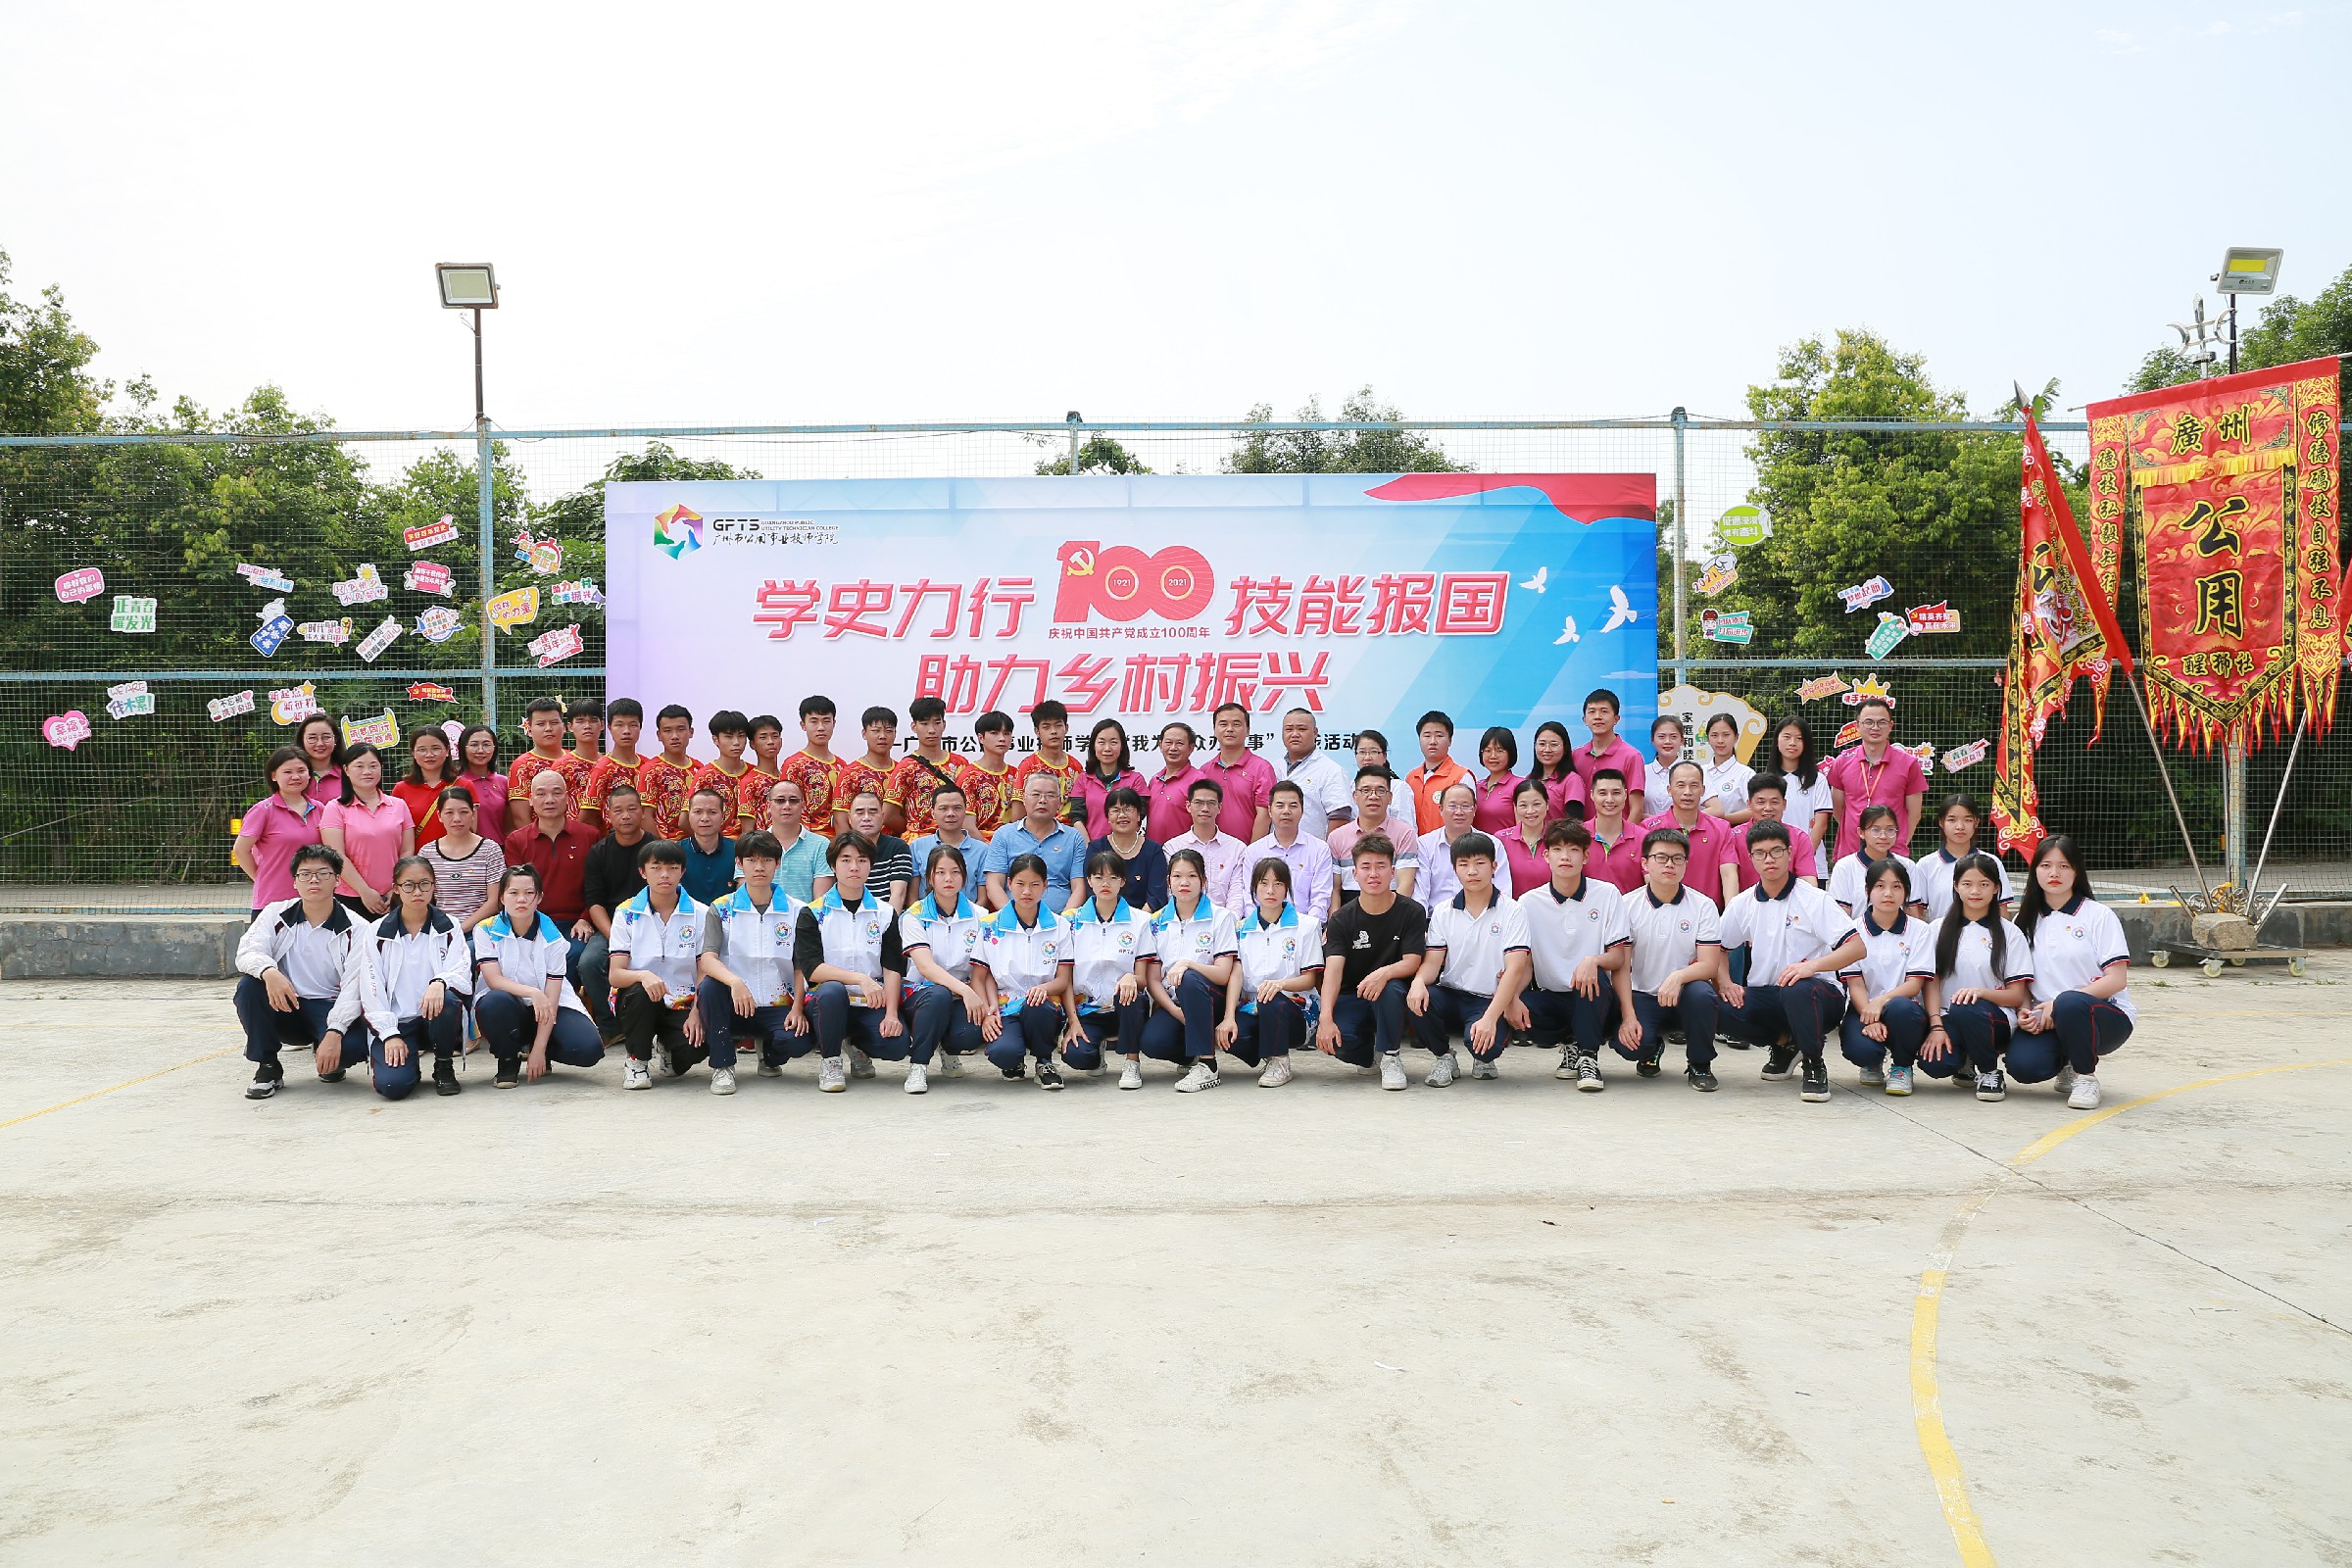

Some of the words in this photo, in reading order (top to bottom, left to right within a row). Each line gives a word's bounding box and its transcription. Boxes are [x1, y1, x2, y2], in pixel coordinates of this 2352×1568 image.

[2170, 404, 2251, 455] 廣州
[712, 519, 760, 531] GPTS
[2179, 496, 2248, 640] 公用
[552, 578, 592, 594] 助力乡村
[1112, 578, 1131, 587] 1921
[1692, 570, 1718, 592] 2021
[116, 598, 154, 613] 正青春
[753, 577, 1035, 640] 学史力行
[1224, 572, 1510, 637] 技能报国
[1049, 627, 1210, 639] 庆祝中国共产党成立100周年
[110, 687, 123, 696] WE
[125, 682, 145, 694] ARE
[912, 652, 1330, 714] 助力乡村振兴
[1682, 712, 1694, 760] 家庭和睦
